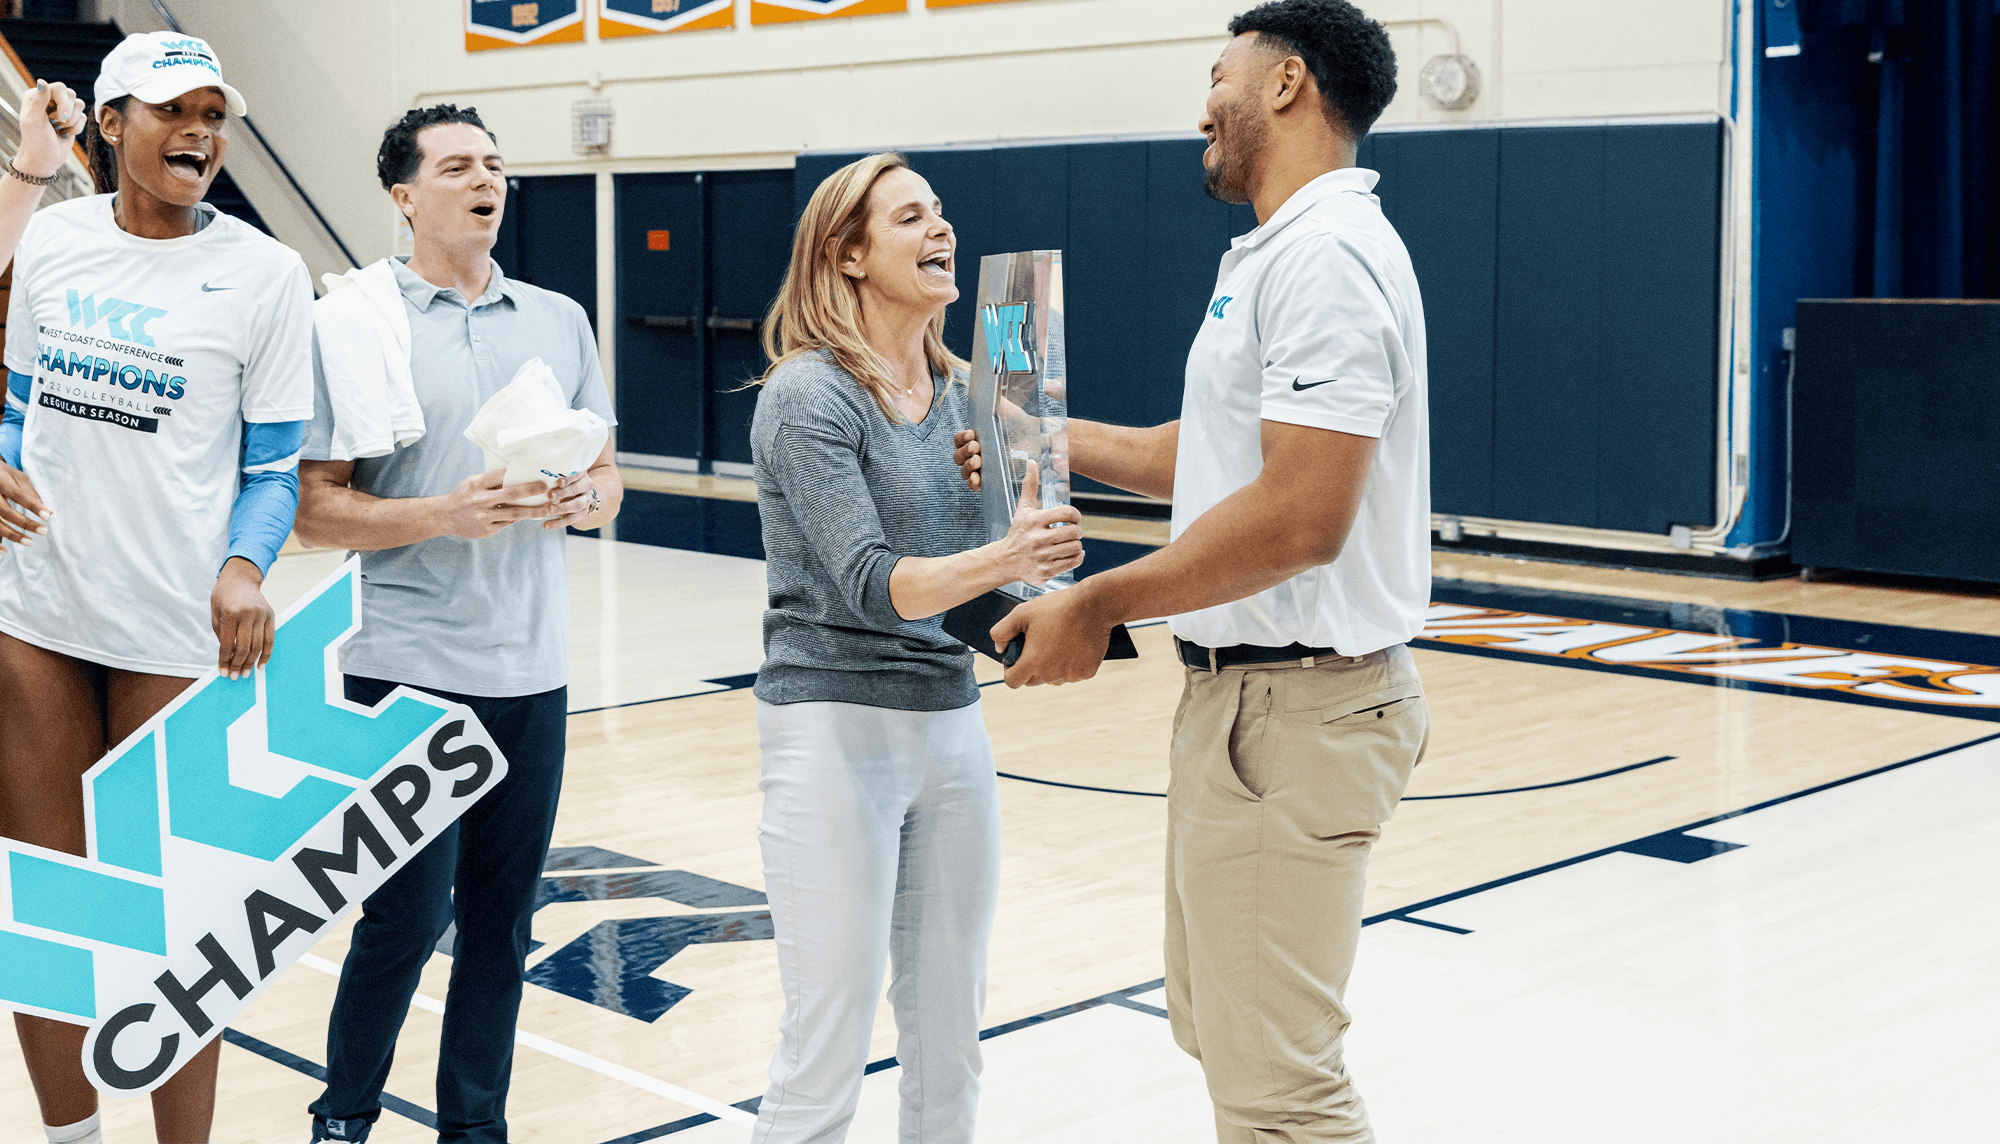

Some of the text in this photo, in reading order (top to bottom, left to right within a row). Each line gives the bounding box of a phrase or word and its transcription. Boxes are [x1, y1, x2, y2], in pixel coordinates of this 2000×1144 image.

[66, 289, 168, 347] WCC
[44, 328, 165, 363] WEST COAST CONFERENCE
[42, 395, 140, 428] REGULAR SEASON
[66, 386, 151, 412] VOLLEYBALL
[92, 718, 494, 1091] CHAMPS
